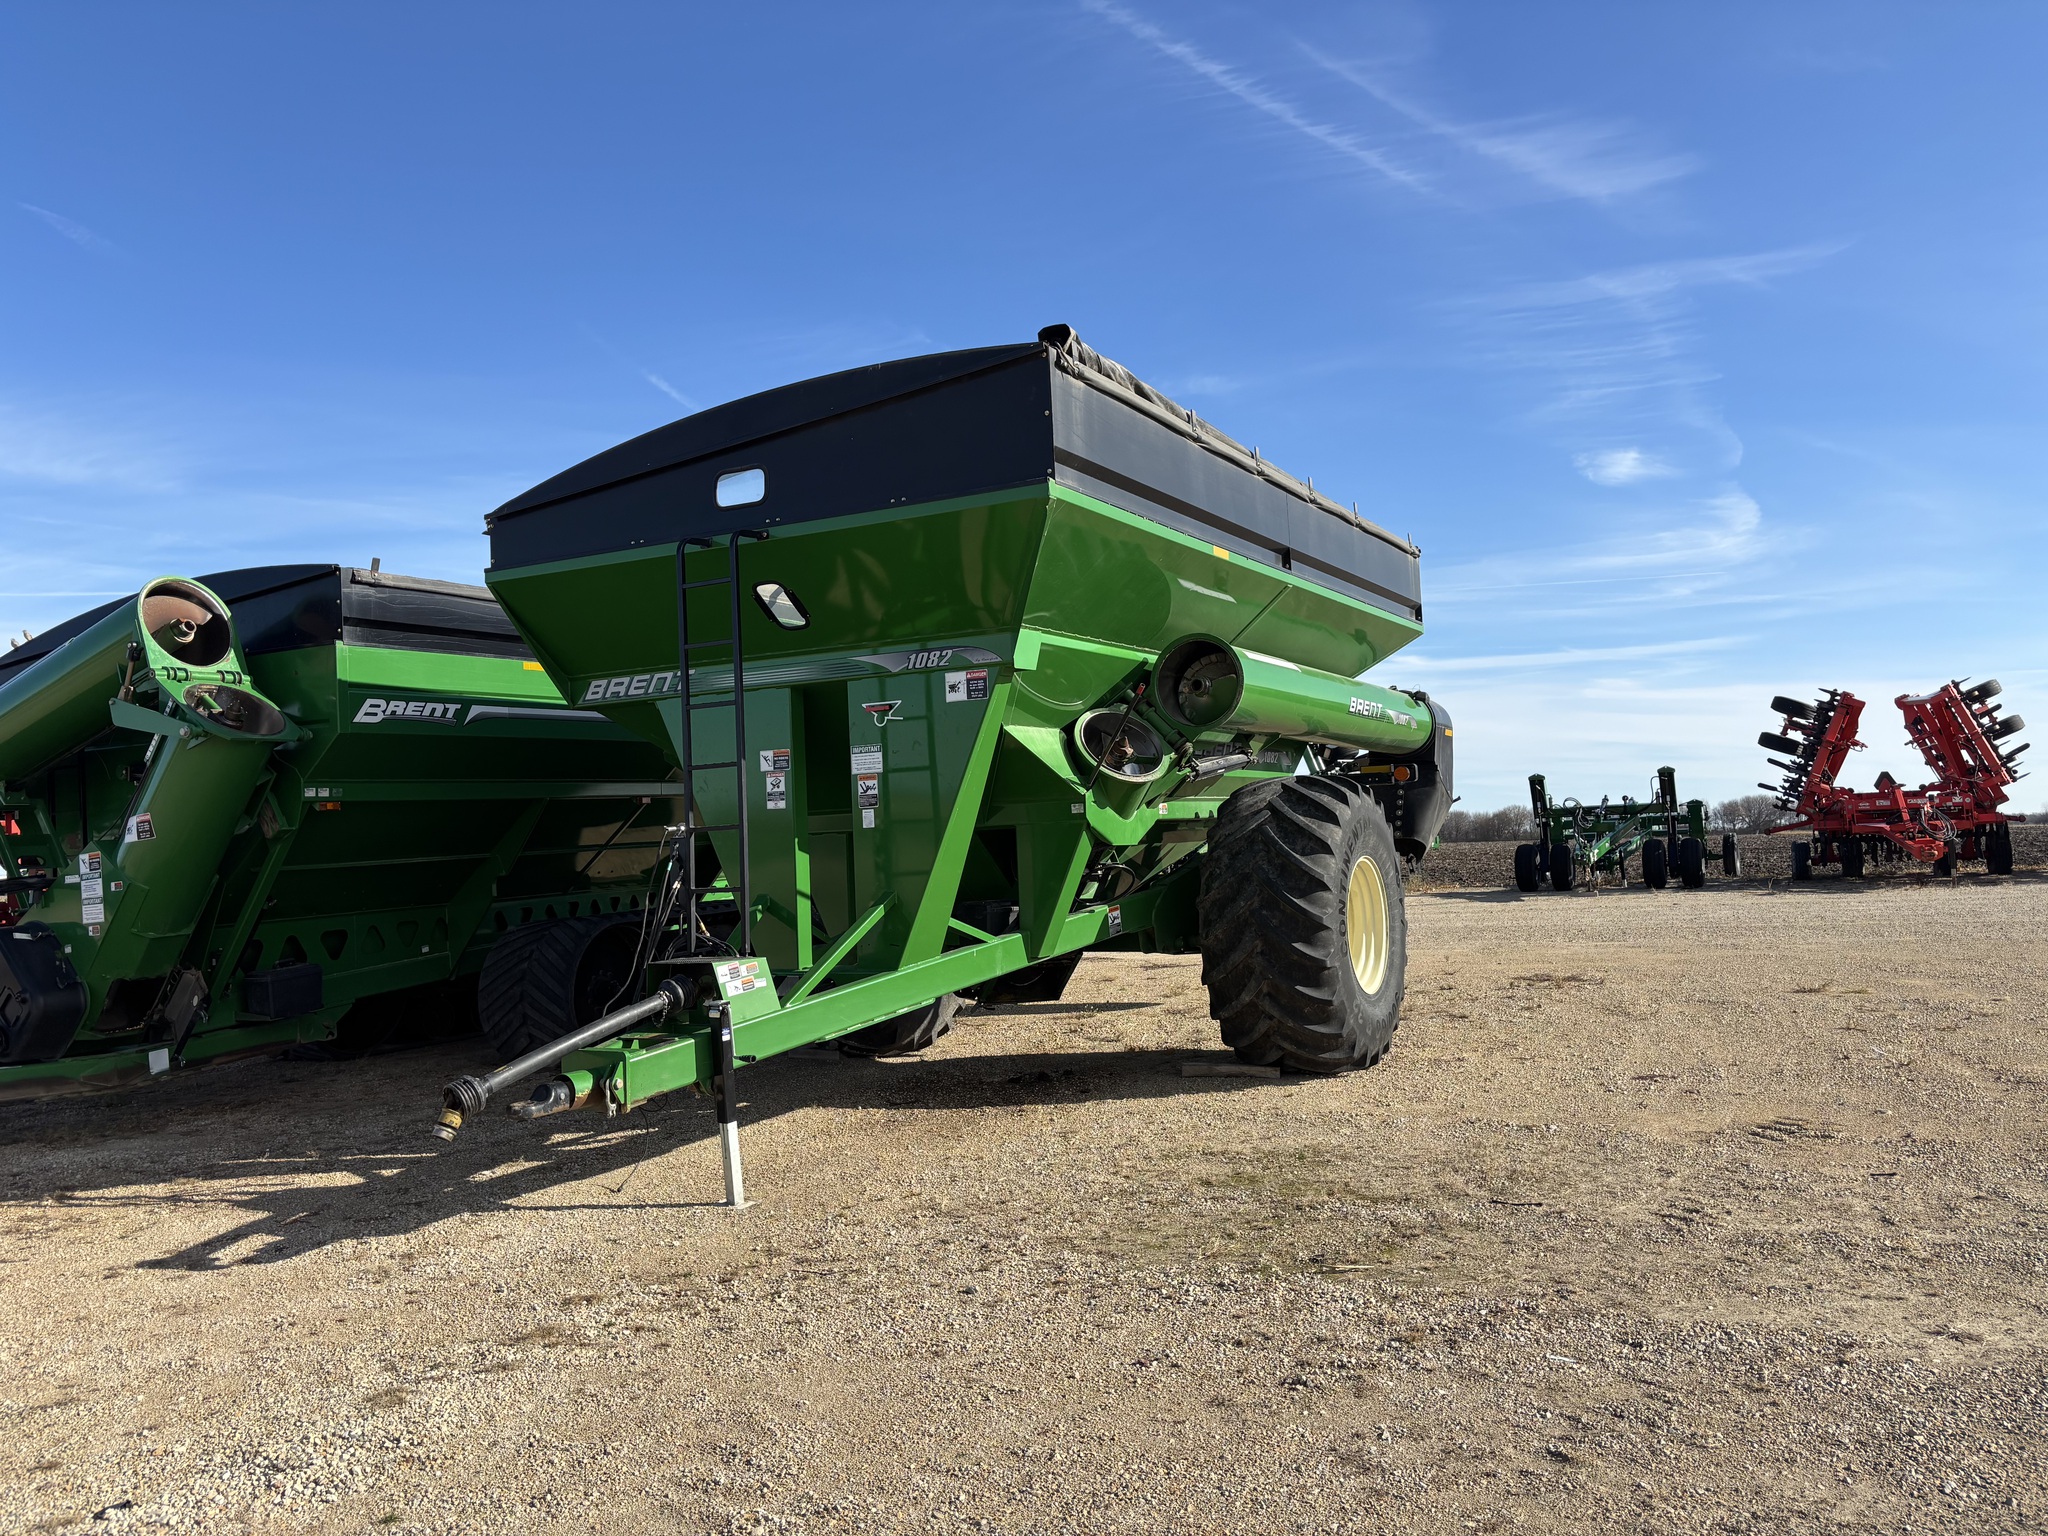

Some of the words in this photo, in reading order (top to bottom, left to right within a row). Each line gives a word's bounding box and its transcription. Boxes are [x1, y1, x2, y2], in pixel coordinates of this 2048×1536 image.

[907, 650, 953, 669] 1082
[585, 669, 696, 700] BRENT
[352, 698, 461, 723] BRENT
[1349, 697, 1383, 717] BRENT
[852, 745, 880, 753] IMPORTANT
[1264, 751, 1279, 764] 1082
[1339, 815, 1371, 958] CONTINENTAL
